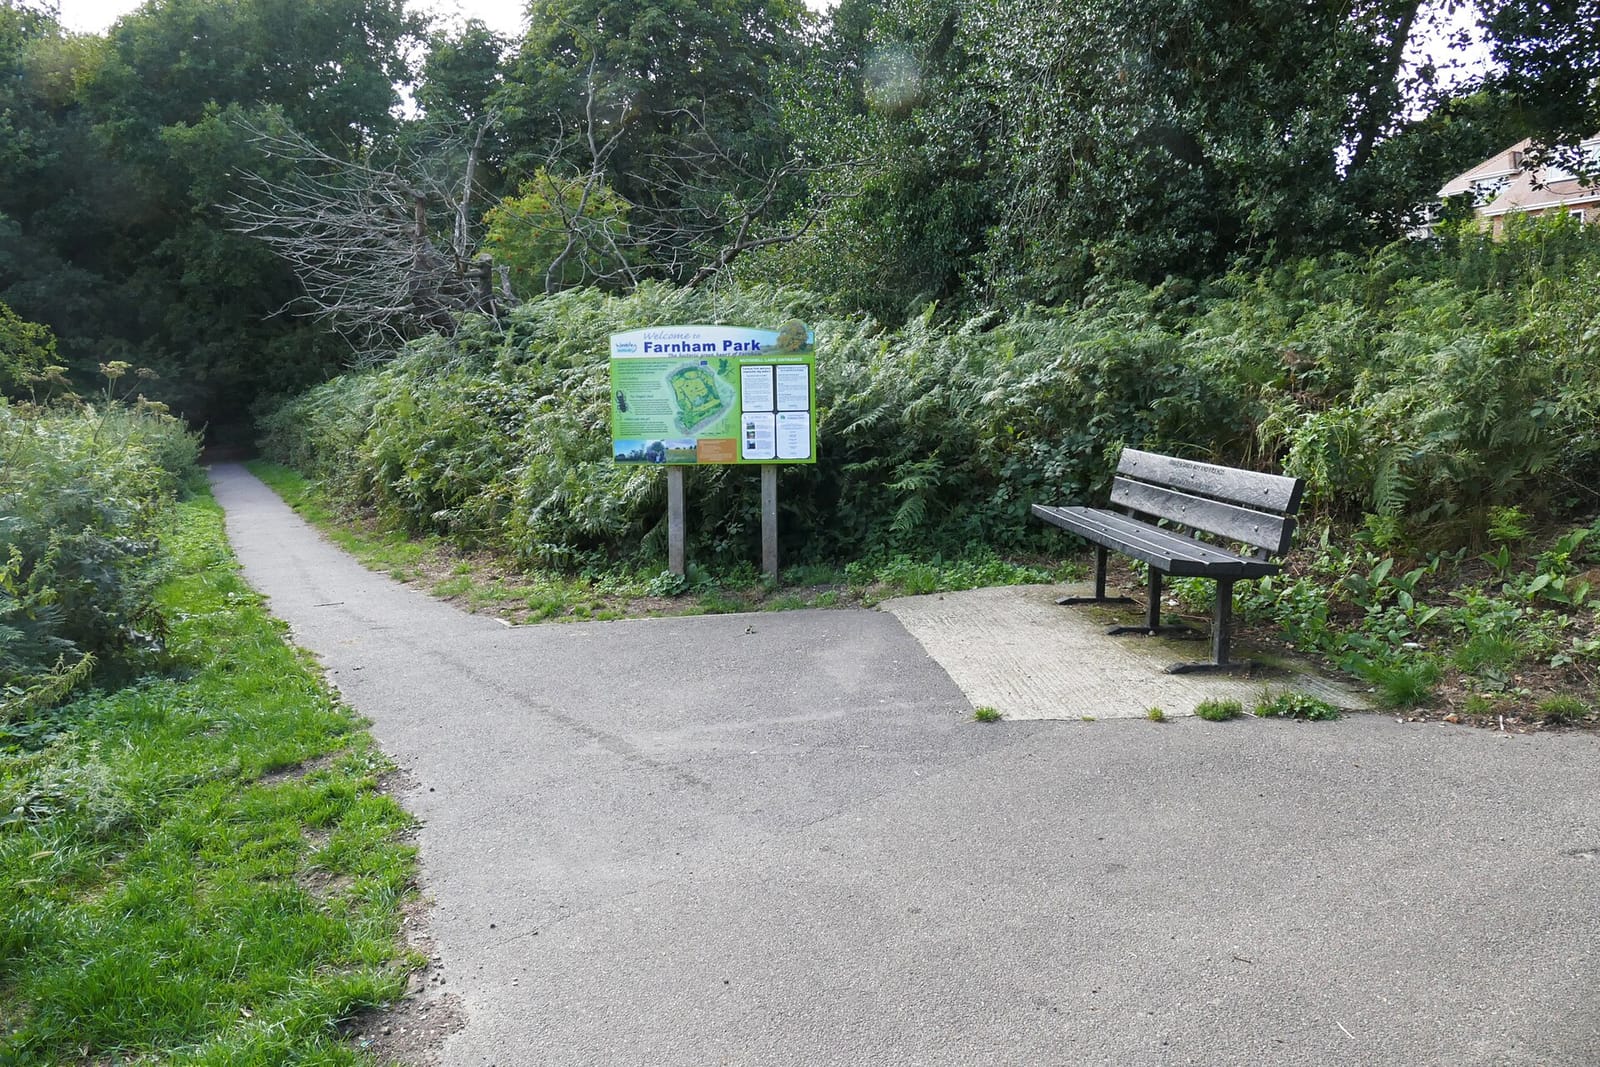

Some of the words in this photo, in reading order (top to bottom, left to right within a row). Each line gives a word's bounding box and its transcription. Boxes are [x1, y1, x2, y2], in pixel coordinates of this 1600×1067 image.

[643, 331, 691, 340] Welcome
[644, 341, 716, 353] Farnham
[723, 339, 761, 351] Park
